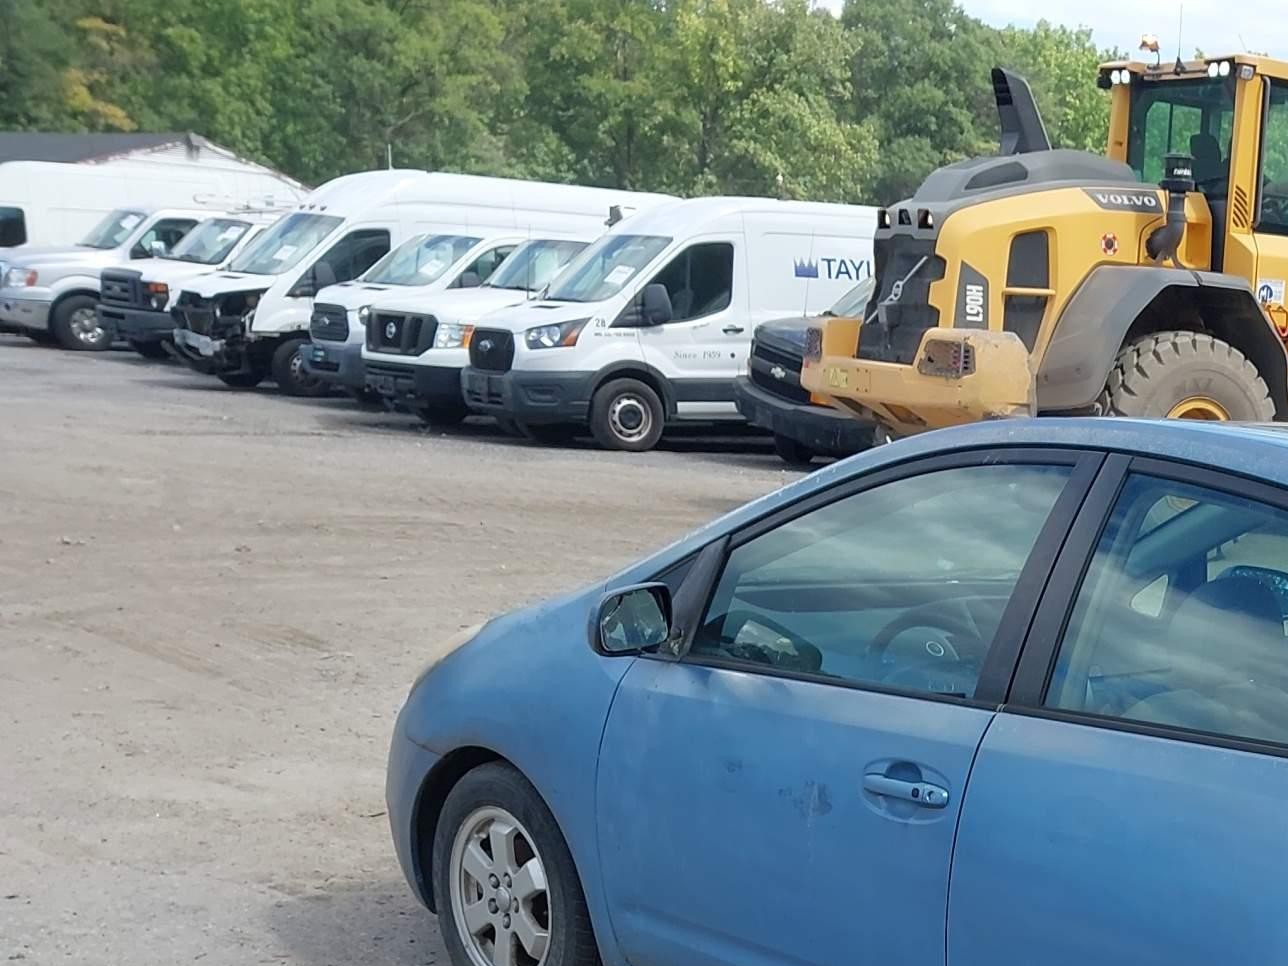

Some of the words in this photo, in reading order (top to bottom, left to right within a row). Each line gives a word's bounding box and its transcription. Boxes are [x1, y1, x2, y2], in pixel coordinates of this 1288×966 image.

[1095, 193, 1156, 207] VOLVO
[966, 284, 983, 321] L90H
[673, 350, 697, 359] Since
